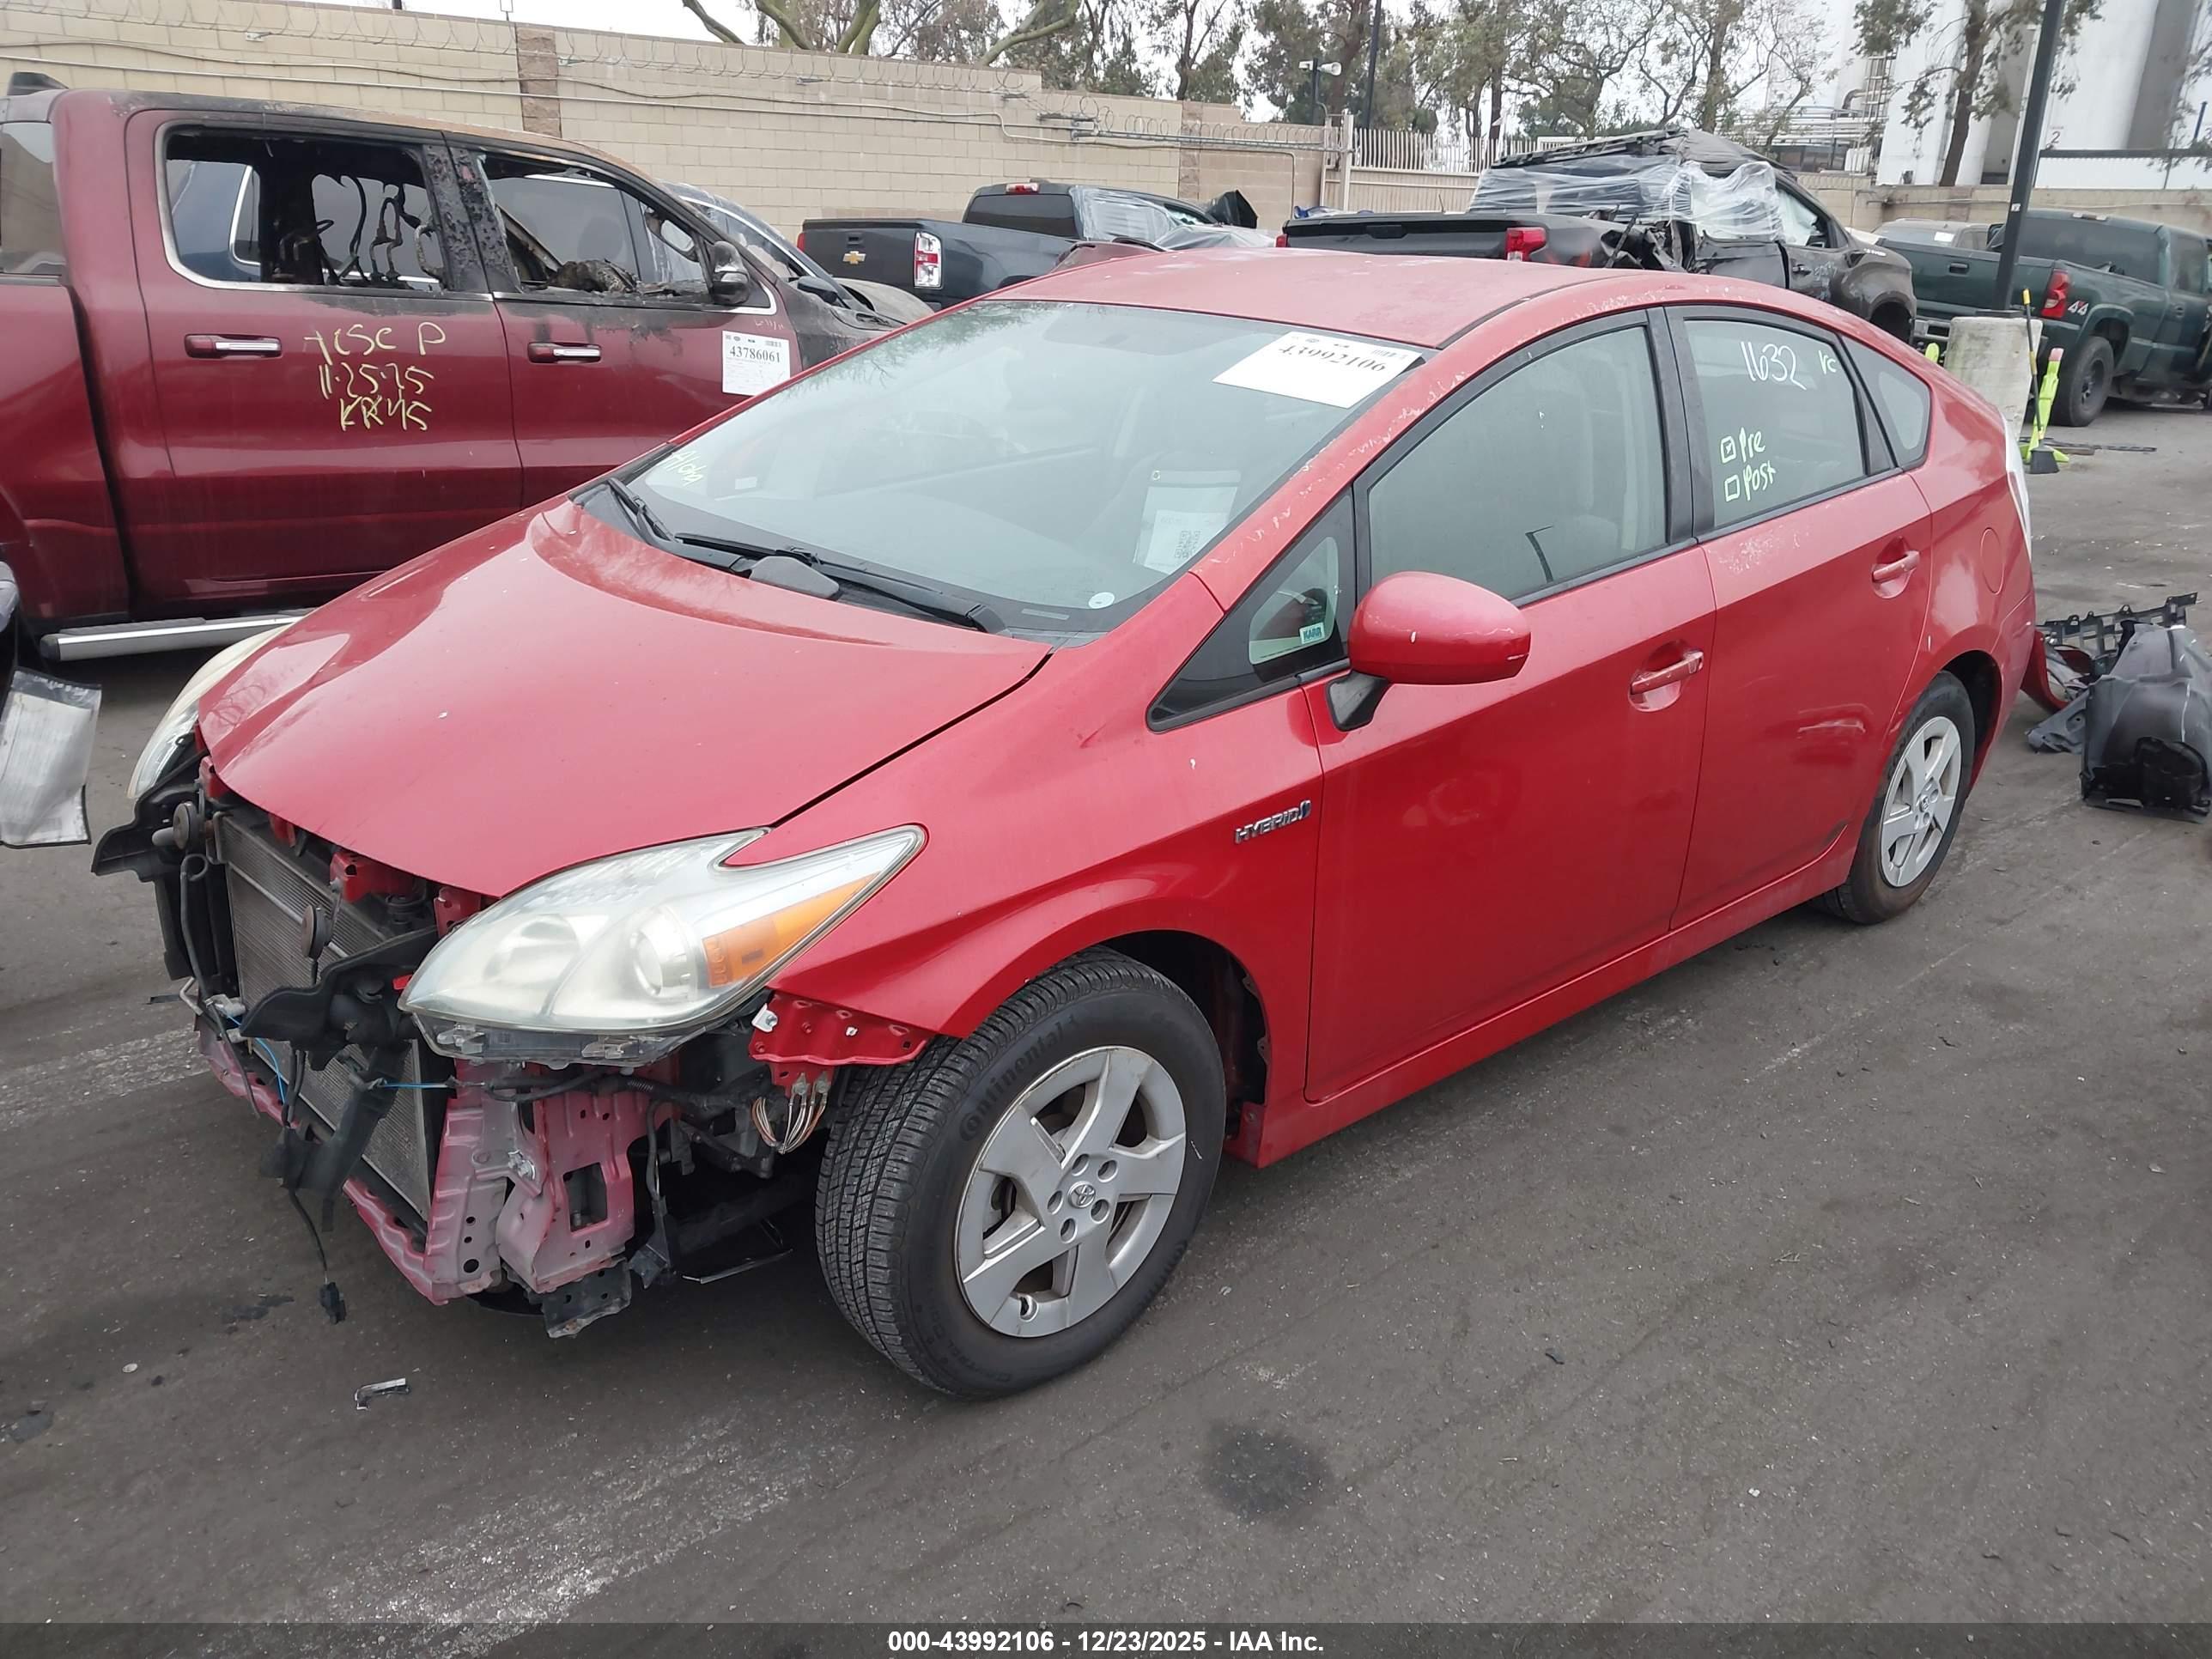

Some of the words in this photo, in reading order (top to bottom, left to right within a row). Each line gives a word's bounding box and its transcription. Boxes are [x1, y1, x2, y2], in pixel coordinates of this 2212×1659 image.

[729, 345, 781, 363] 43786061
[1279, 344, 1386, 372] 43992106
[1741, 341, 1807, 390] 1632
[1235, 807, 1299, 844] HYBRID
